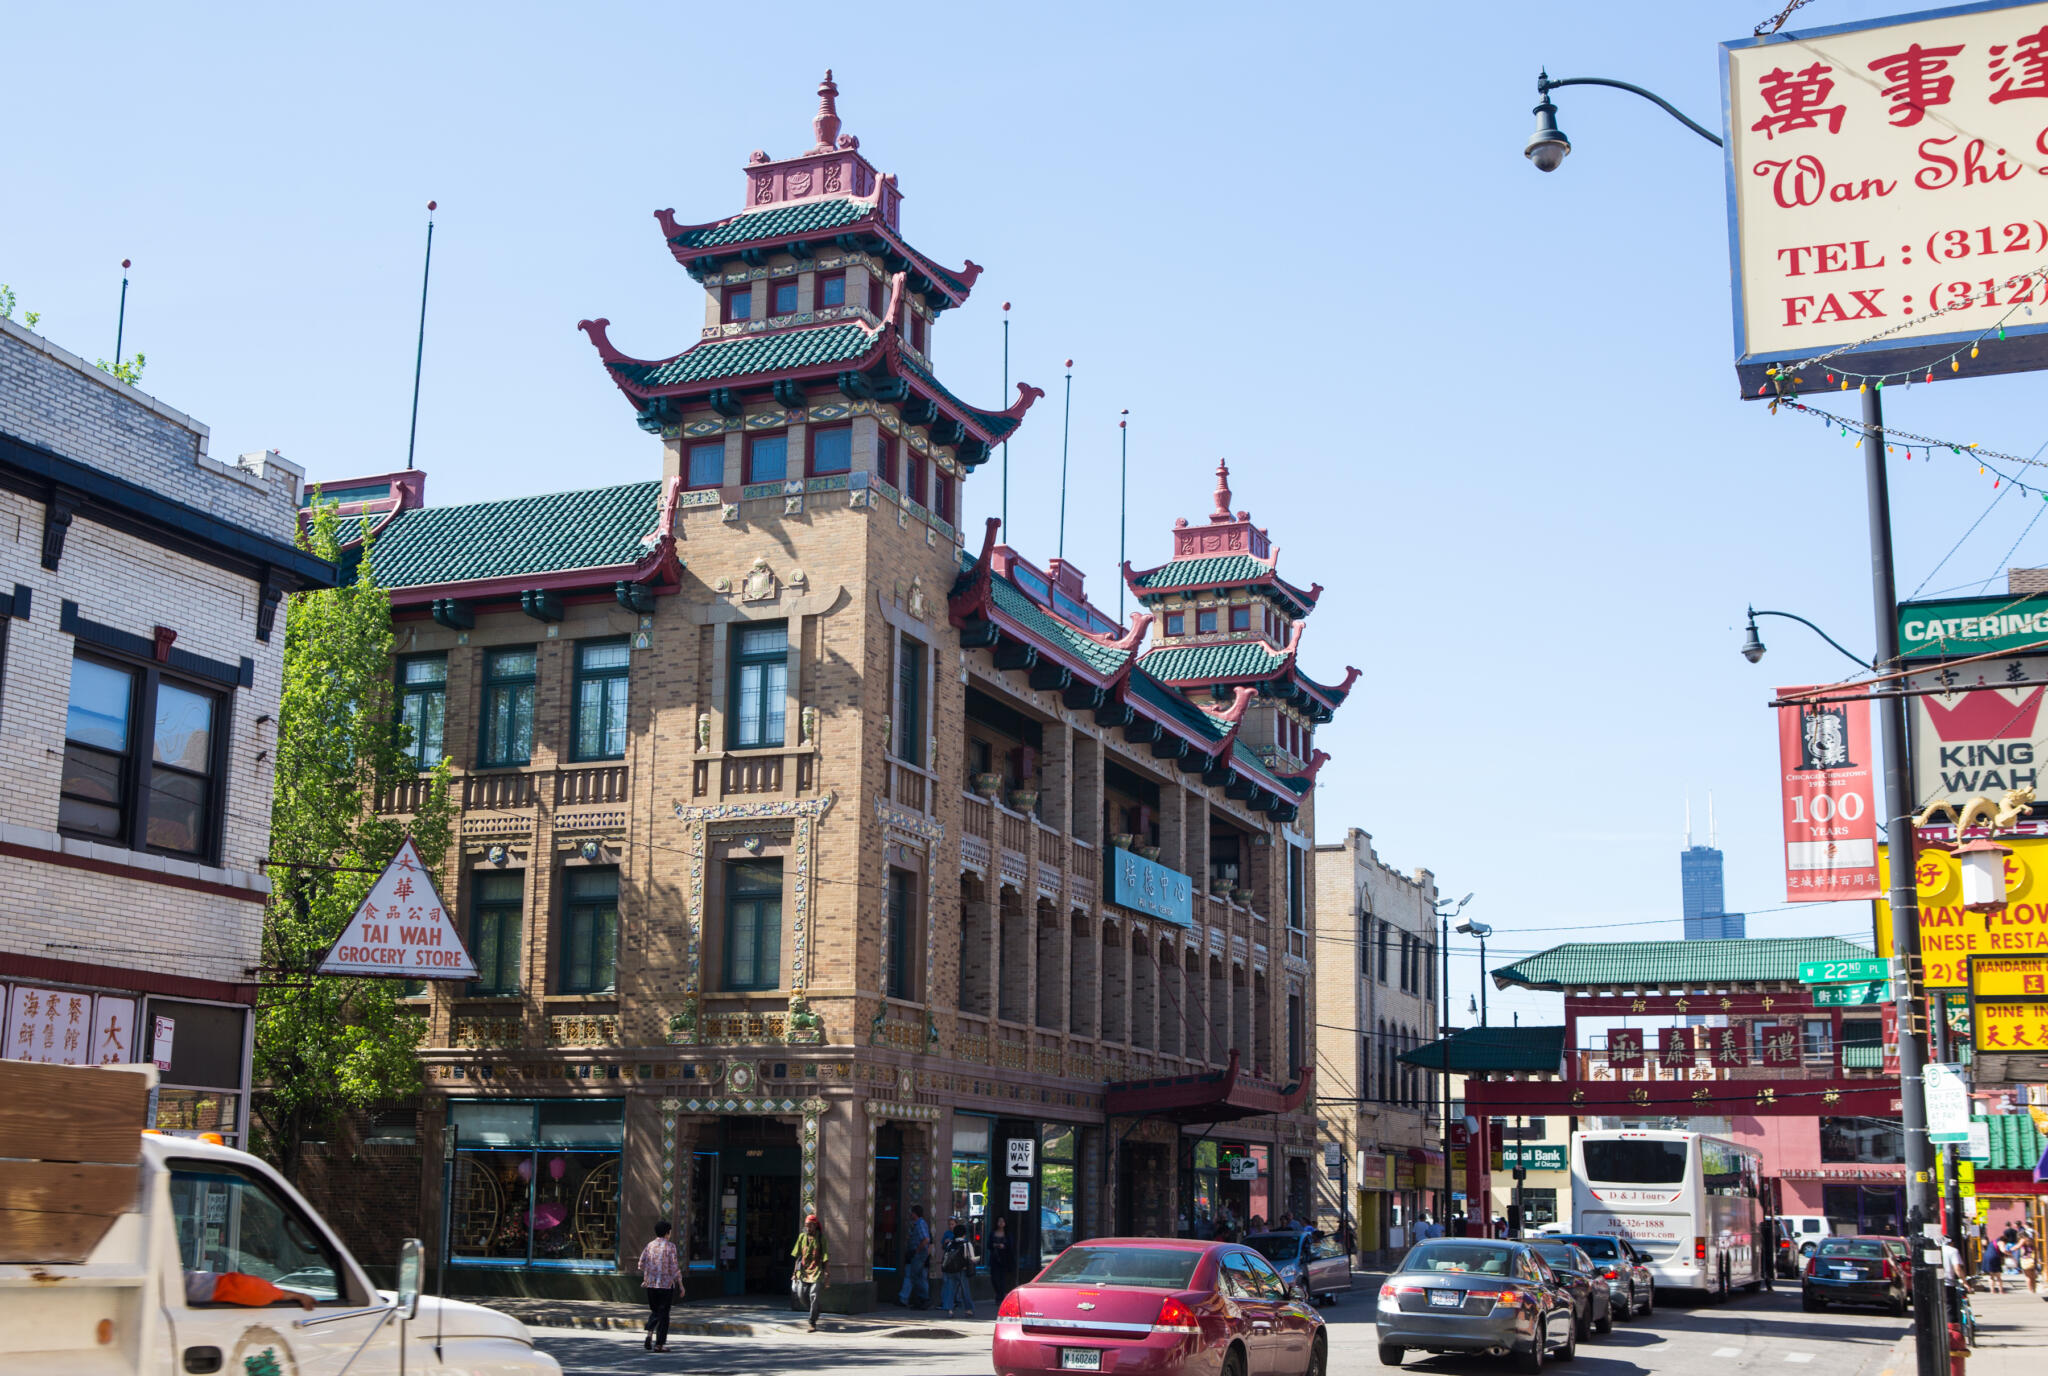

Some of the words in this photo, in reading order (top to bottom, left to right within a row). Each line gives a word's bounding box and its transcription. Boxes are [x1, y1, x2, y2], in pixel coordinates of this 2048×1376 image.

[1753, 155, 1897, 208] Wan
[1915, 135, 2023, 190] Shi
[1926, 220, 2048, 264] (312)
[1904, 613, 2048, 641] CATERING
[1940, 742, 2033, 768] KING
[1940, 768, 2037, 793] WAH
[1791, 792, 1864, 823] 100
[1809, 826, 1849, 836] YEARS
[361, 902, 441, 923] 食品公司
[1919, 905, 1967, 927] MAY
[361, 924, 389, 944] TAI
[400, 926, 442, 947] WAH
[338, 946, 407, 964] GROCERY
[415, 950, 461, 967] STORE
[1806, 968, 1814, 976] W
[1824, 962, 1861, 979] 22ND
[1869, 965, 1880, 974] PL
[1976, 960, 2041, 973] MANDARIN
[1986, 1005, 2024, 1018] DINE
[2034, 1005, 2048, 1017] IN
[1011, 1142, 1030, 1151] ONE
[1534, 1149, 1560, 1161] Bank
[1010, 1153, 1030, 1161] WAY
[1778, 1168, 1818, 1179] THREE
[1823, 1168, 1895, 1179] HAPPINESS
[1609, 1191, 1617, 1200] D
[1620, 1191, 1628, 1200] &
[1631, 1192, 1637, 1200] J
[1641, 1191, 1667, 1200] Tours
[1608, 1218, 1664, 1228] 312-326-1888
[1072, 1353, 1098, 1365] 160268
